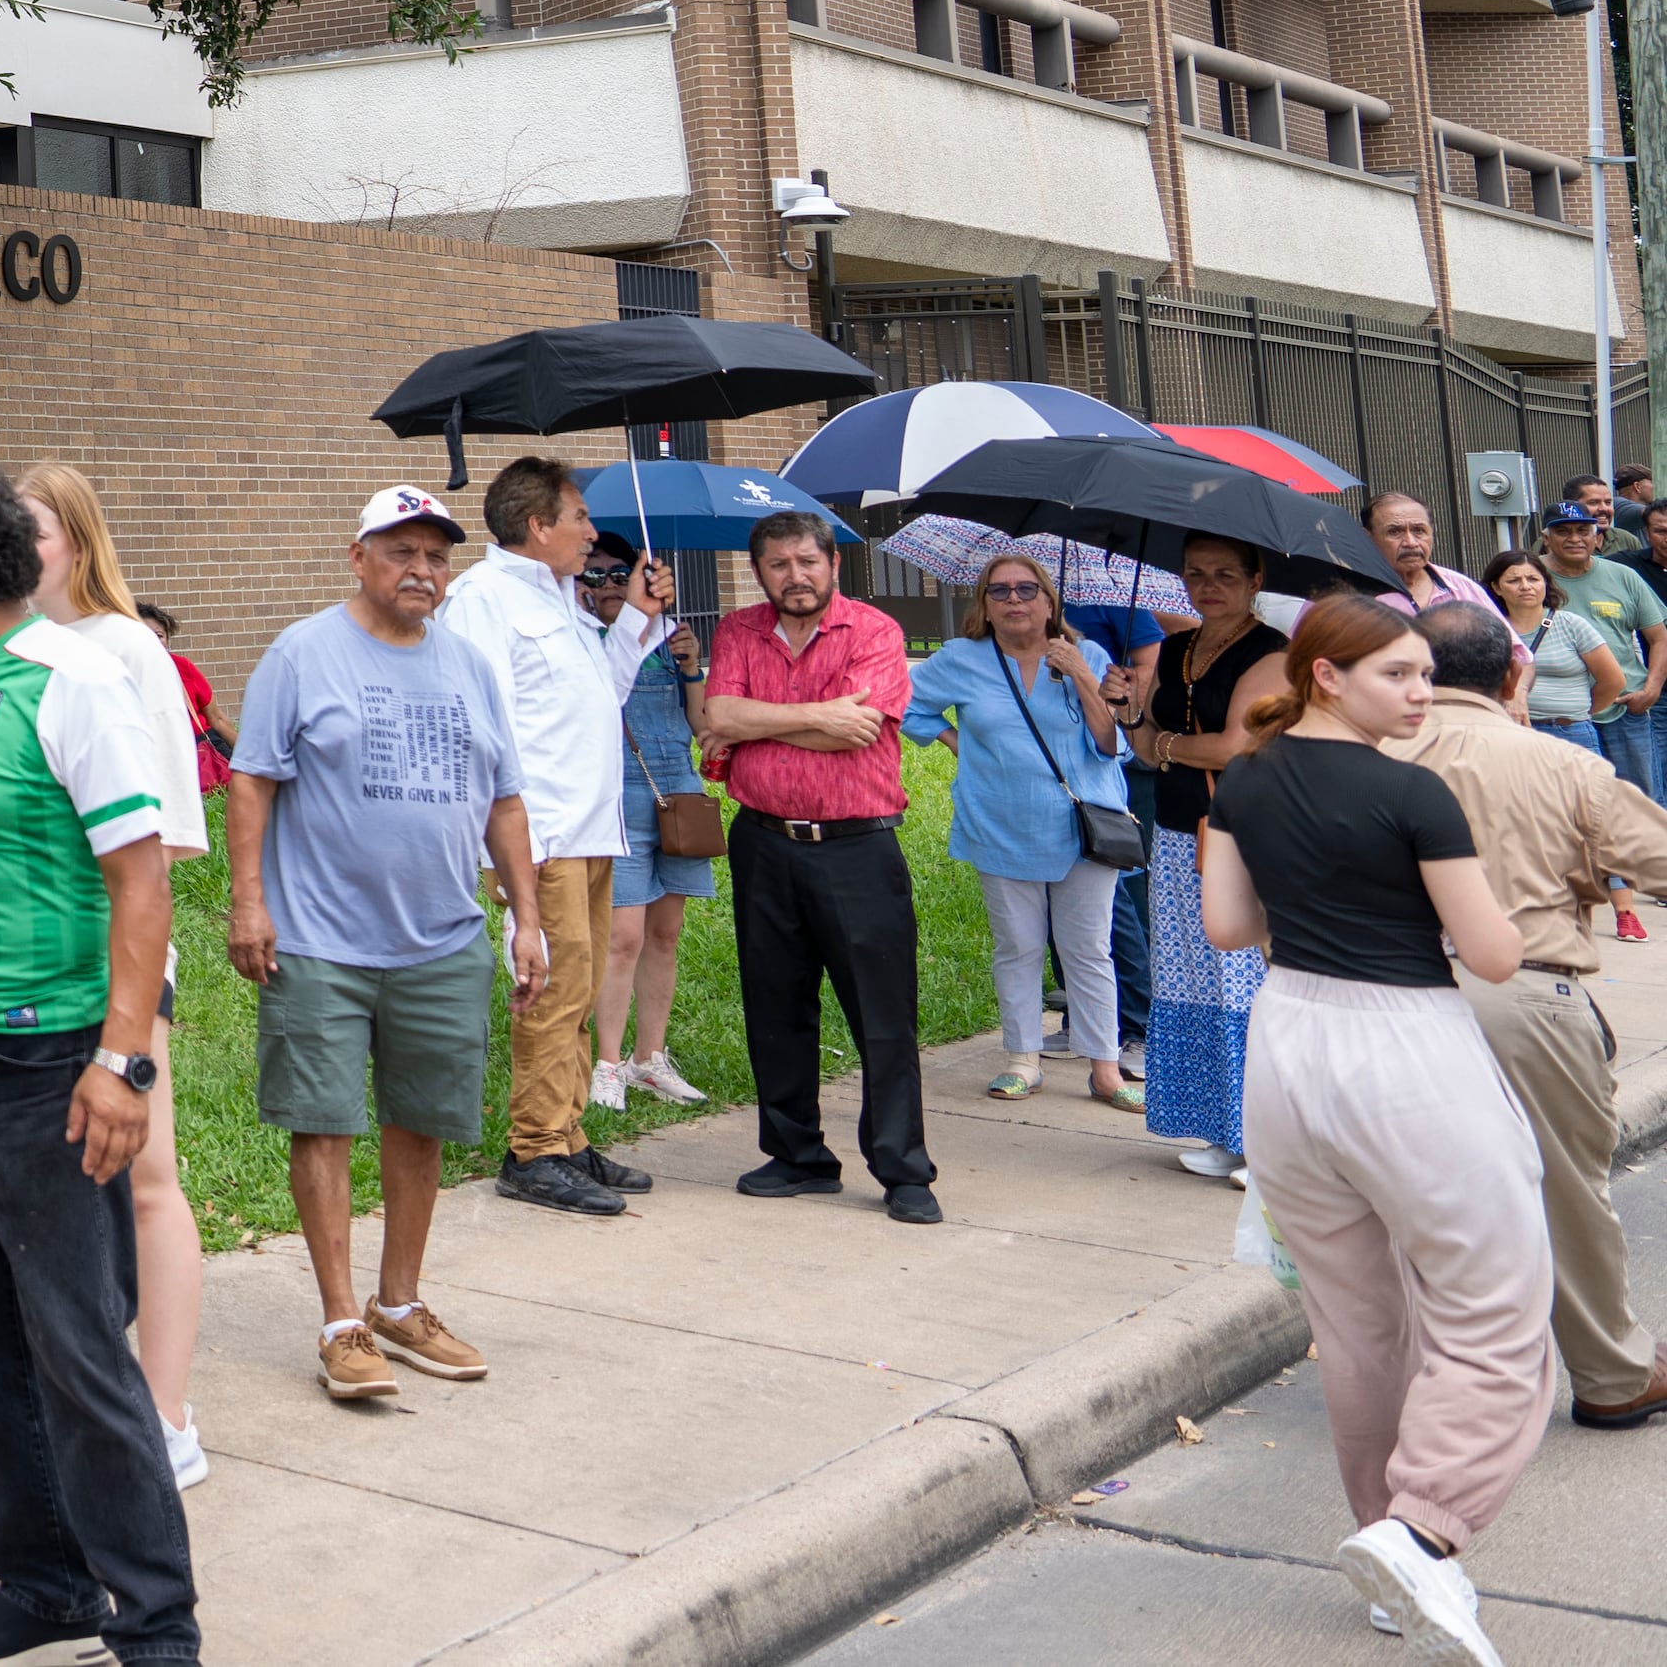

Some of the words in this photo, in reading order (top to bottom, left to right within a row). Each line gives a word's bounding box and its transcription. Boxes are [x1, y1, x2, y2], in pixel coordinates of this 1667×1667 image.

[363, 685, 393, 694] NEVER
[365, 696, 386, 704] GIVE
[368, 706, 380, 714] UP
[414, 705, 423, 720] THE
[426, 705, 436, 732] TODAY
[438, 705, 447, 720] THE
[369, 717, 397, 728] GREAT
[370, 729, 402, 740] THINGS
[439, 722, 449, 743] PAIN
[370, 741, 393, 751] TAKE
[406, 723, 417, 769] TOMORROW
[415, 722, 428, 762] STRENGTH
[428, 734, 438, 753] WILL
[440, 745, 450, 762] YOU
[421, 765, 430, 782] YOU
[442, 764, 451, 781] FEEL
[363, 783, 403, 801] NEVER
[408, 787, 435, 804] GIVE
[439, 790, 450, 805] IN
